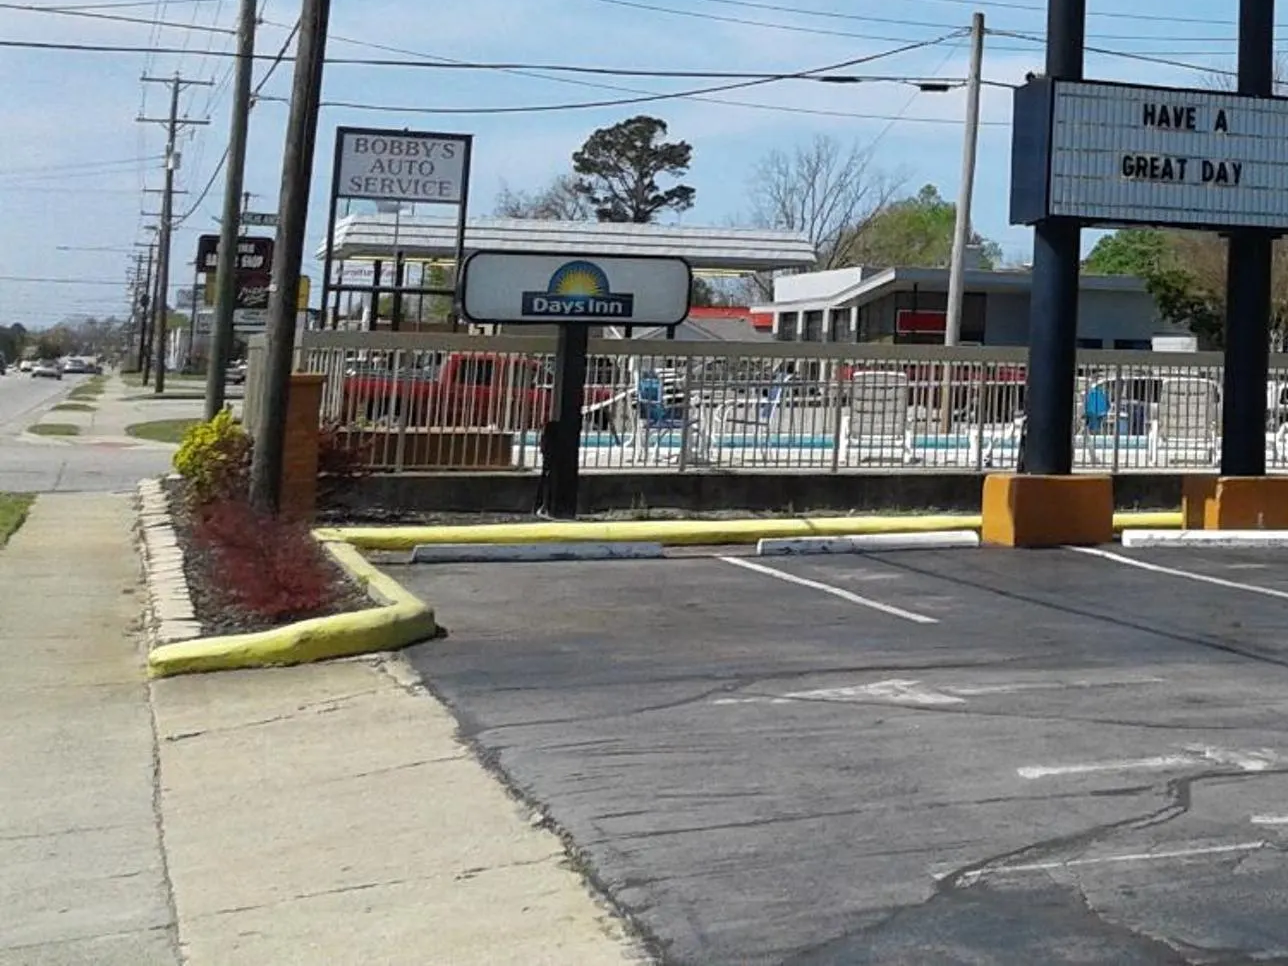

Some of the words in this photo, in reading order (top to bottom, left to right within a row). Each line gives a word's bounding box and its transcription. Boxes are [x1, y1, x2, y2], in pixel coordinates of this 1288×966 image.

[1143, 103, 1196, 129] HAVE
[1214, 109, 1228, 132] A
[353, 137, 455, 159] BOBBY'S
[370, 158, 435, 176] AUTO
[1122, 155, 1188, 180] GREAT
[1202, 160, 1243, 184] DAY
[348, 176, 453, 197] SERVICE
[532, 297, 585, 314] Days
[588, 299, 622, 314] Inn
